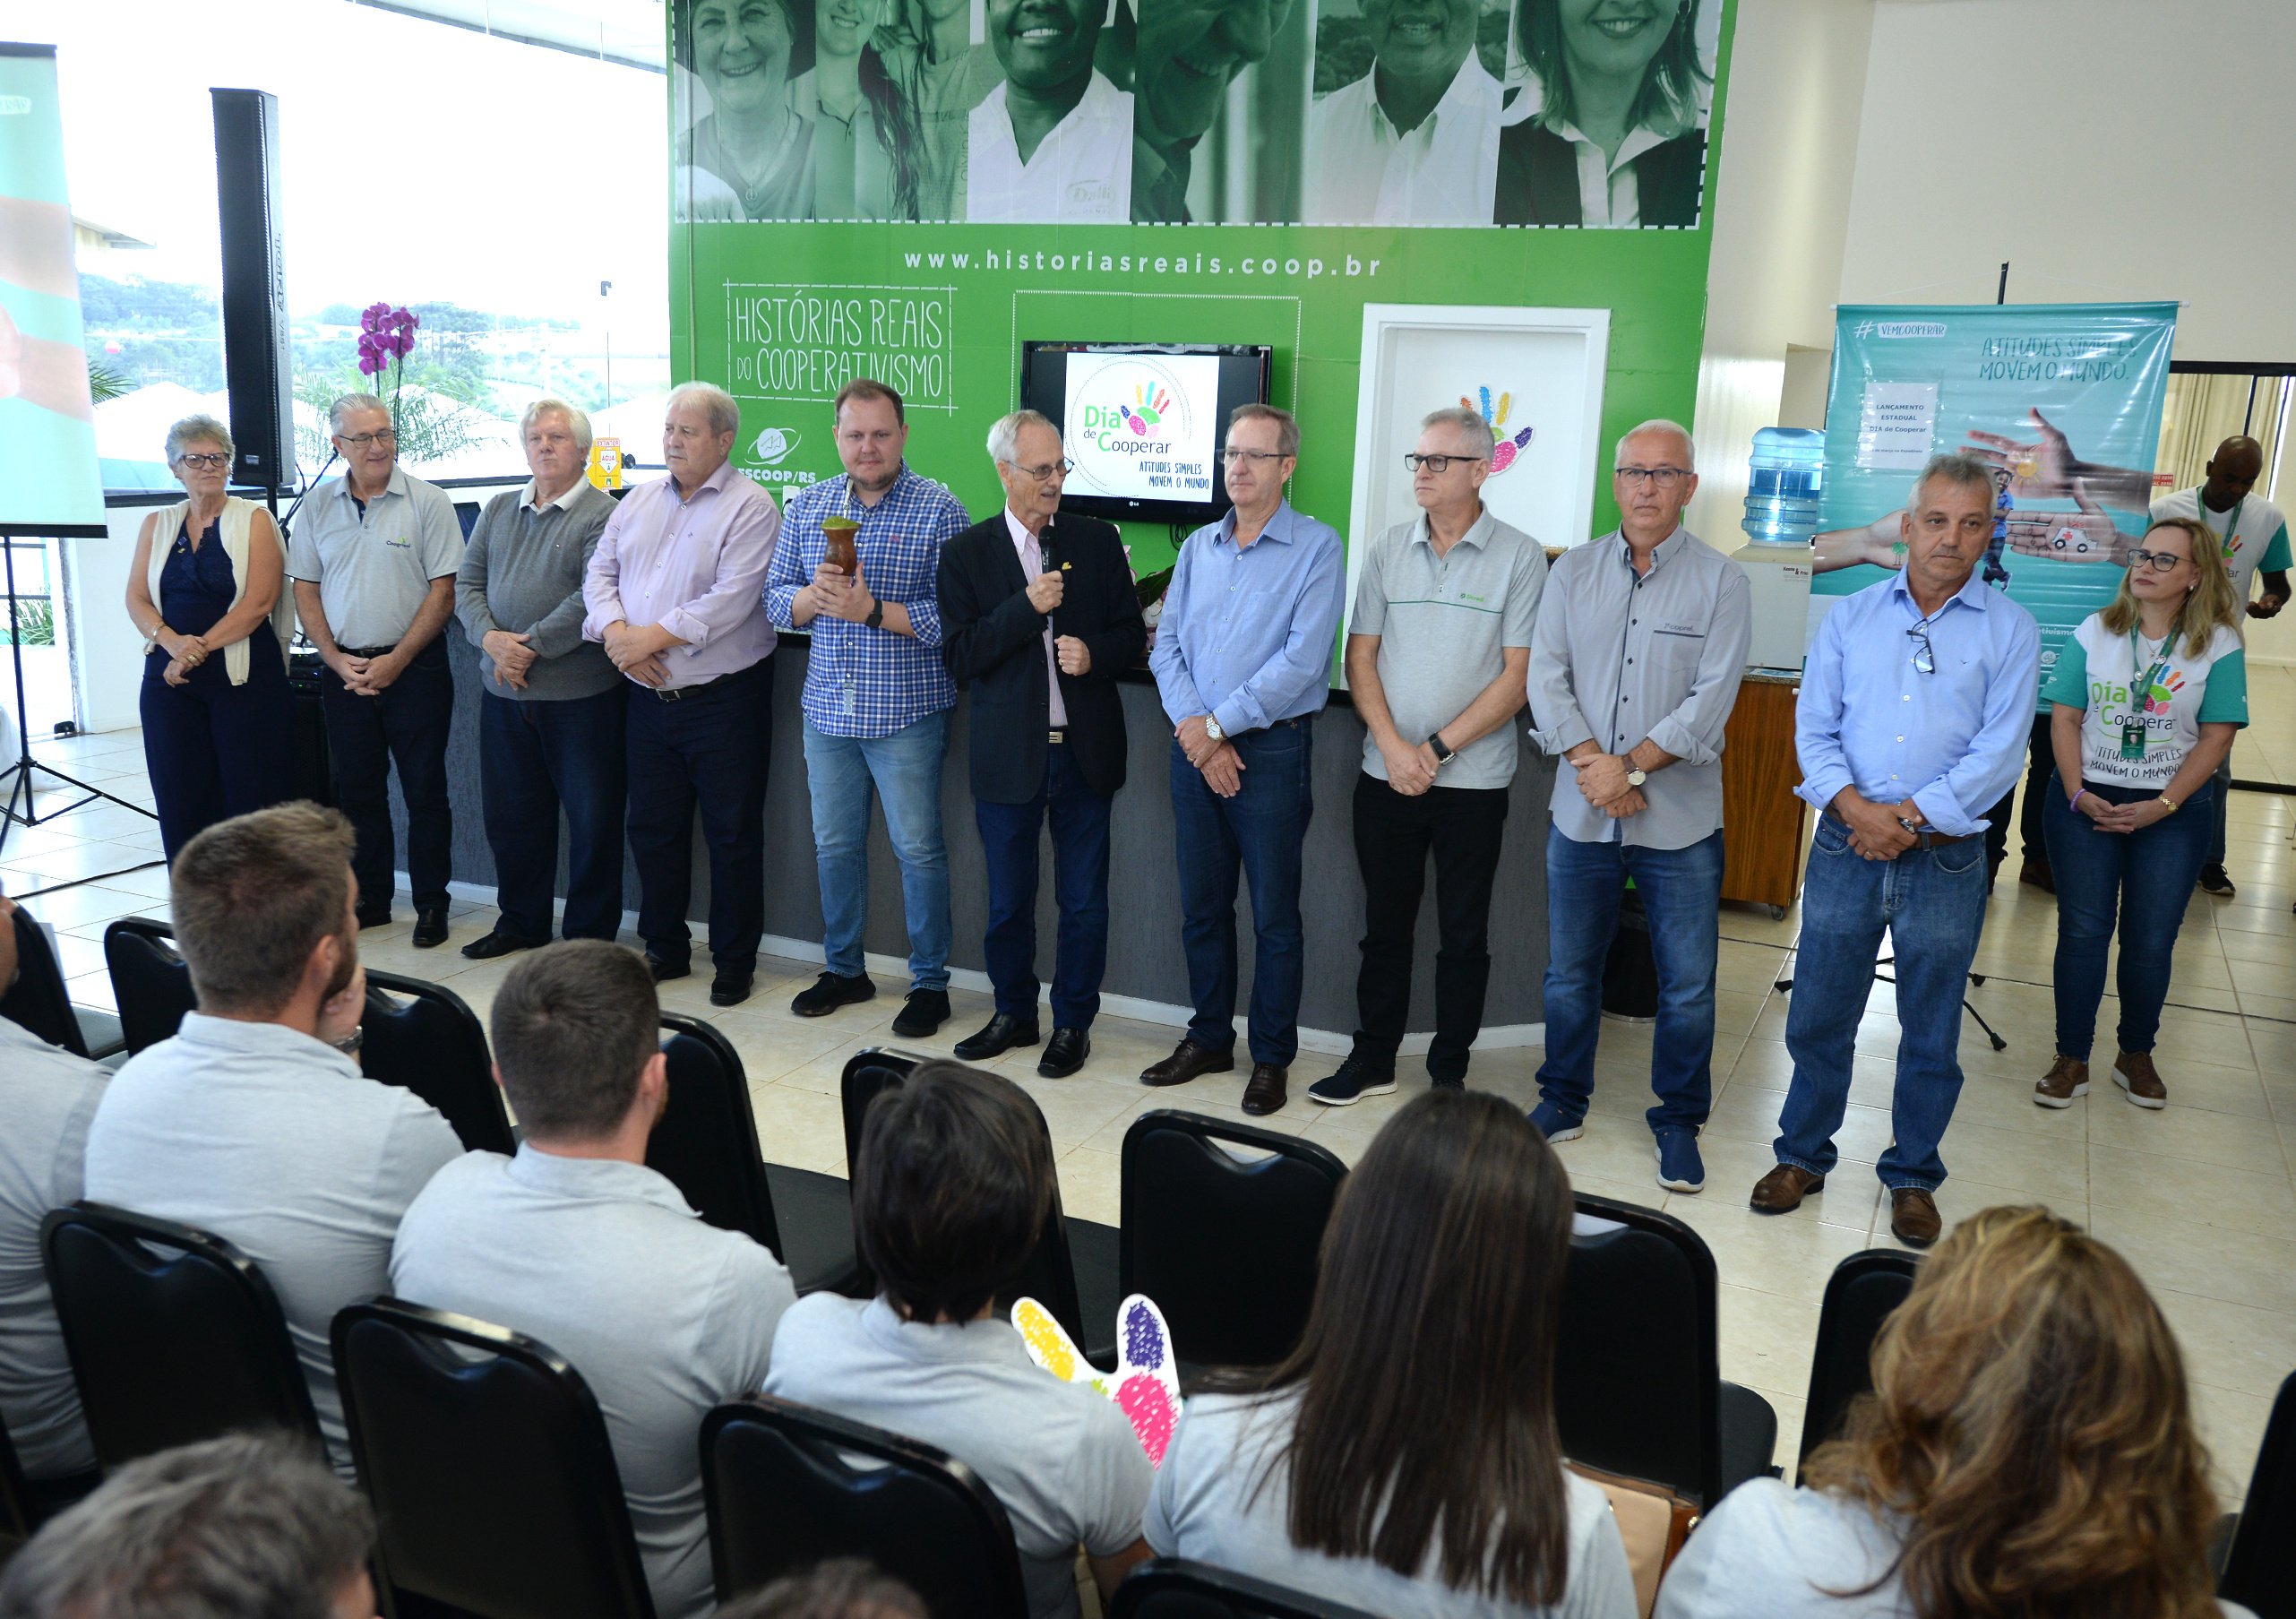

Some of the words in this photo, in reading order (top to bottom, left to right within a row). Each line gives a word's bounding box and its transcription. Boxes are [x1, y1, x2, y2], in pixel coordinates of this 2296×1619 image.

[904, 249, 1380, 279] www.historiasreais.coop.br
[735, 289, 862, 347] HISTÓRIAS
[870, 299, 942, 349] REAIS
[737, 357, 752, 380] DO
[757, 348, 942, 398] COOPERATIVISMO
[1978, 360, 2042, 381] MOVEM
[2045, 361, 2058, 380] O
[1084, 405, 1121, 428] Dia
[1083, 428, 1096, 439] de
[1097, 431, 1172, 455] Cooperar
[1148, 476, 1174, 488] MOVEM
[1176, 477, 1182, 488] O
[1184, 478, 1209, 490] MUNDO
[2092, 681, 2127, 704] Dia
[2101, 704, 2177, 729] Coopera
[2090, 760, 2128, 778] MOVEM
[2132, 768, 2139, 779] O
